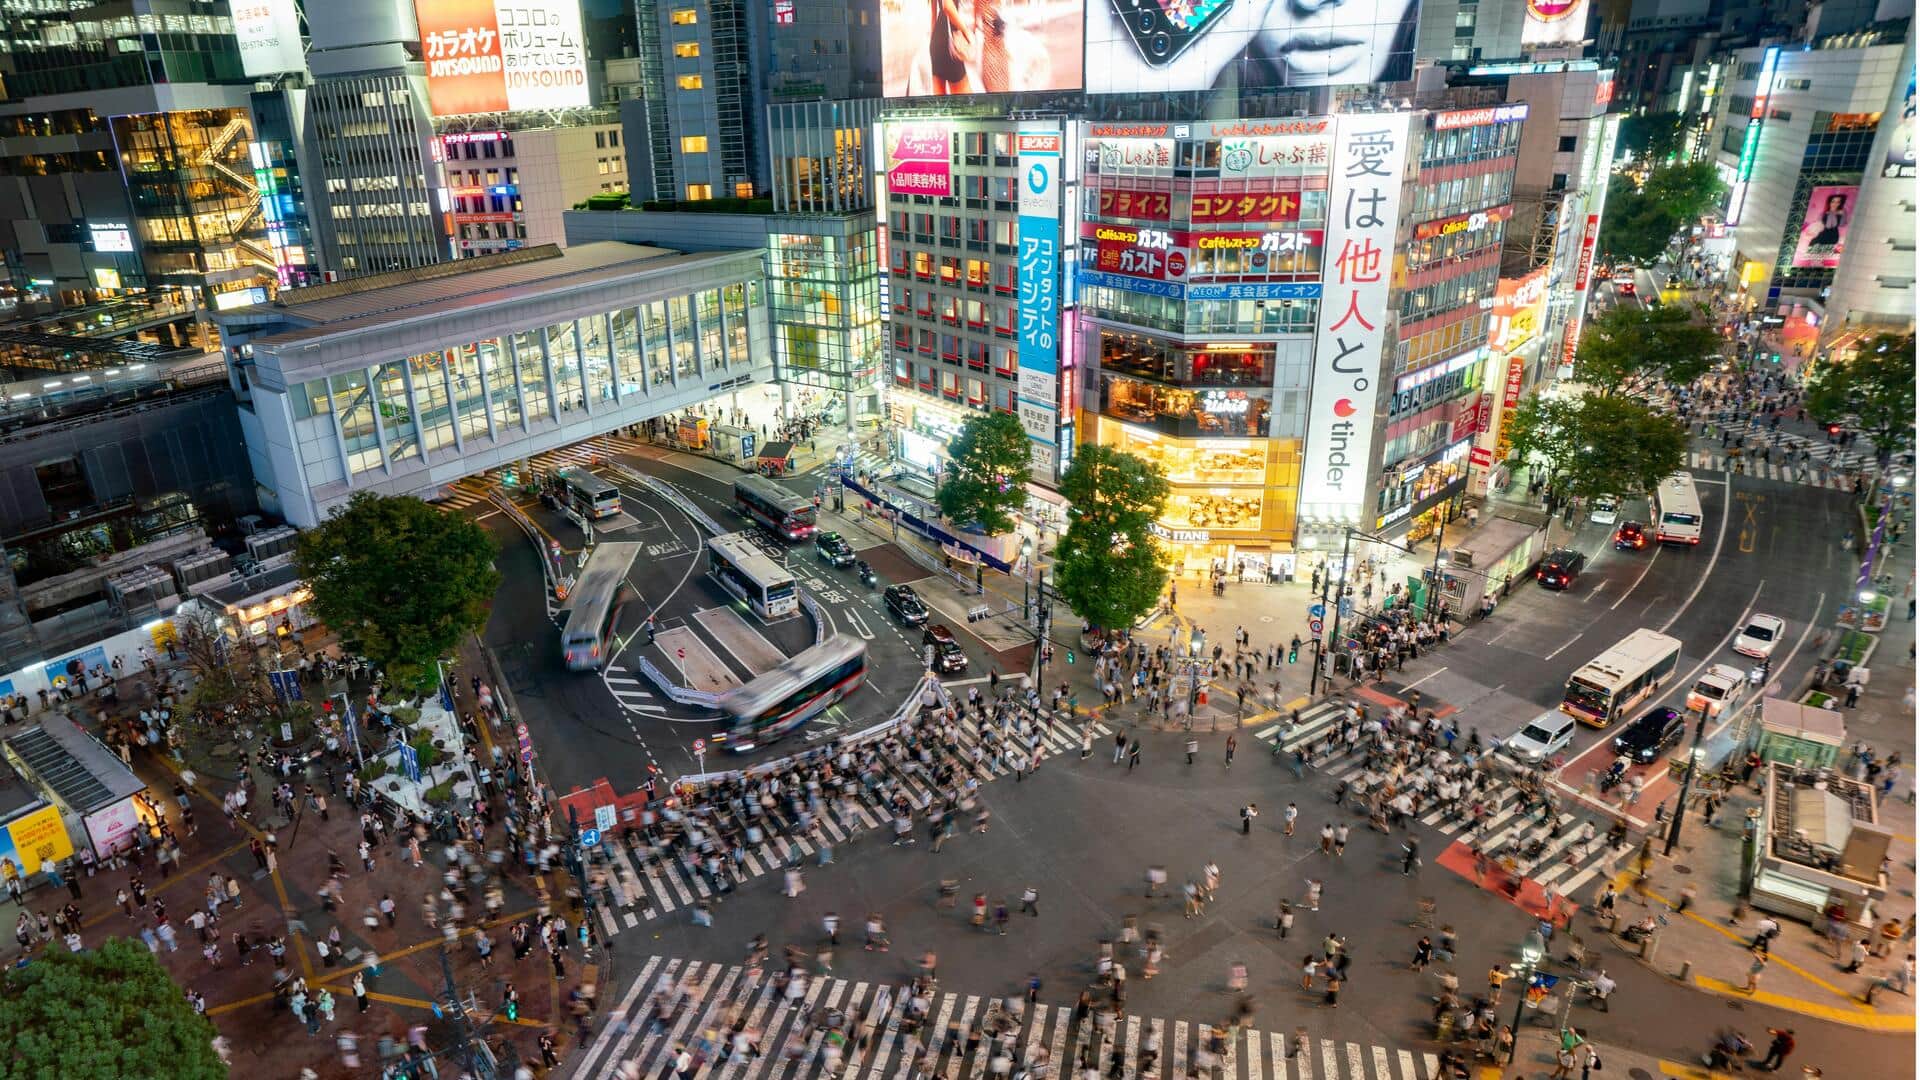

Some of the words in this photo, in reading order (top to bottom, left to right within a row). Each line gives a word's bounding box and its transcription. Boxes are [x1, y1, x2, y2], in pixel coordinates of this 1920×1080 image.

[500, 8, 560, 26] ココロの
[426, 27, 496, 58] カラオケ
[504, 29, 580, 49] ボリューム、
[431, 55, 501, 78] JOYSOUND
[505, 51, 583, 67] あげていこう。
[508, 69, 584, 89] JOYSOUND
[1086, 150, 1099, 162] 9F
[1125, 145, 1169, 167] しゃぶ葉
[1259, 142, 1327, 165] しゃぶ葉
[896, 173, 947, 190] 品川美容外科
[1192, 195, 1297, 216] コンタクト
[1137, 229, 1174, 250] ガスト
[1260, 232, 1312, 251] ガスト
[1083, 247, 1099, 261] 7F
[1121, 249, 1162, 274] ガスト
[1329, 129, 1394, 392] 愛は他人と。
[1022, 236, 1040, 346] アイシティ
[1041, 239, 1053, 349] コンタクトの
[1193, 287, 1221, 298] AEON
[1229, 285, 1320, 298] 英会話イーオン
[1326, 420, 1354, 492] tinder
